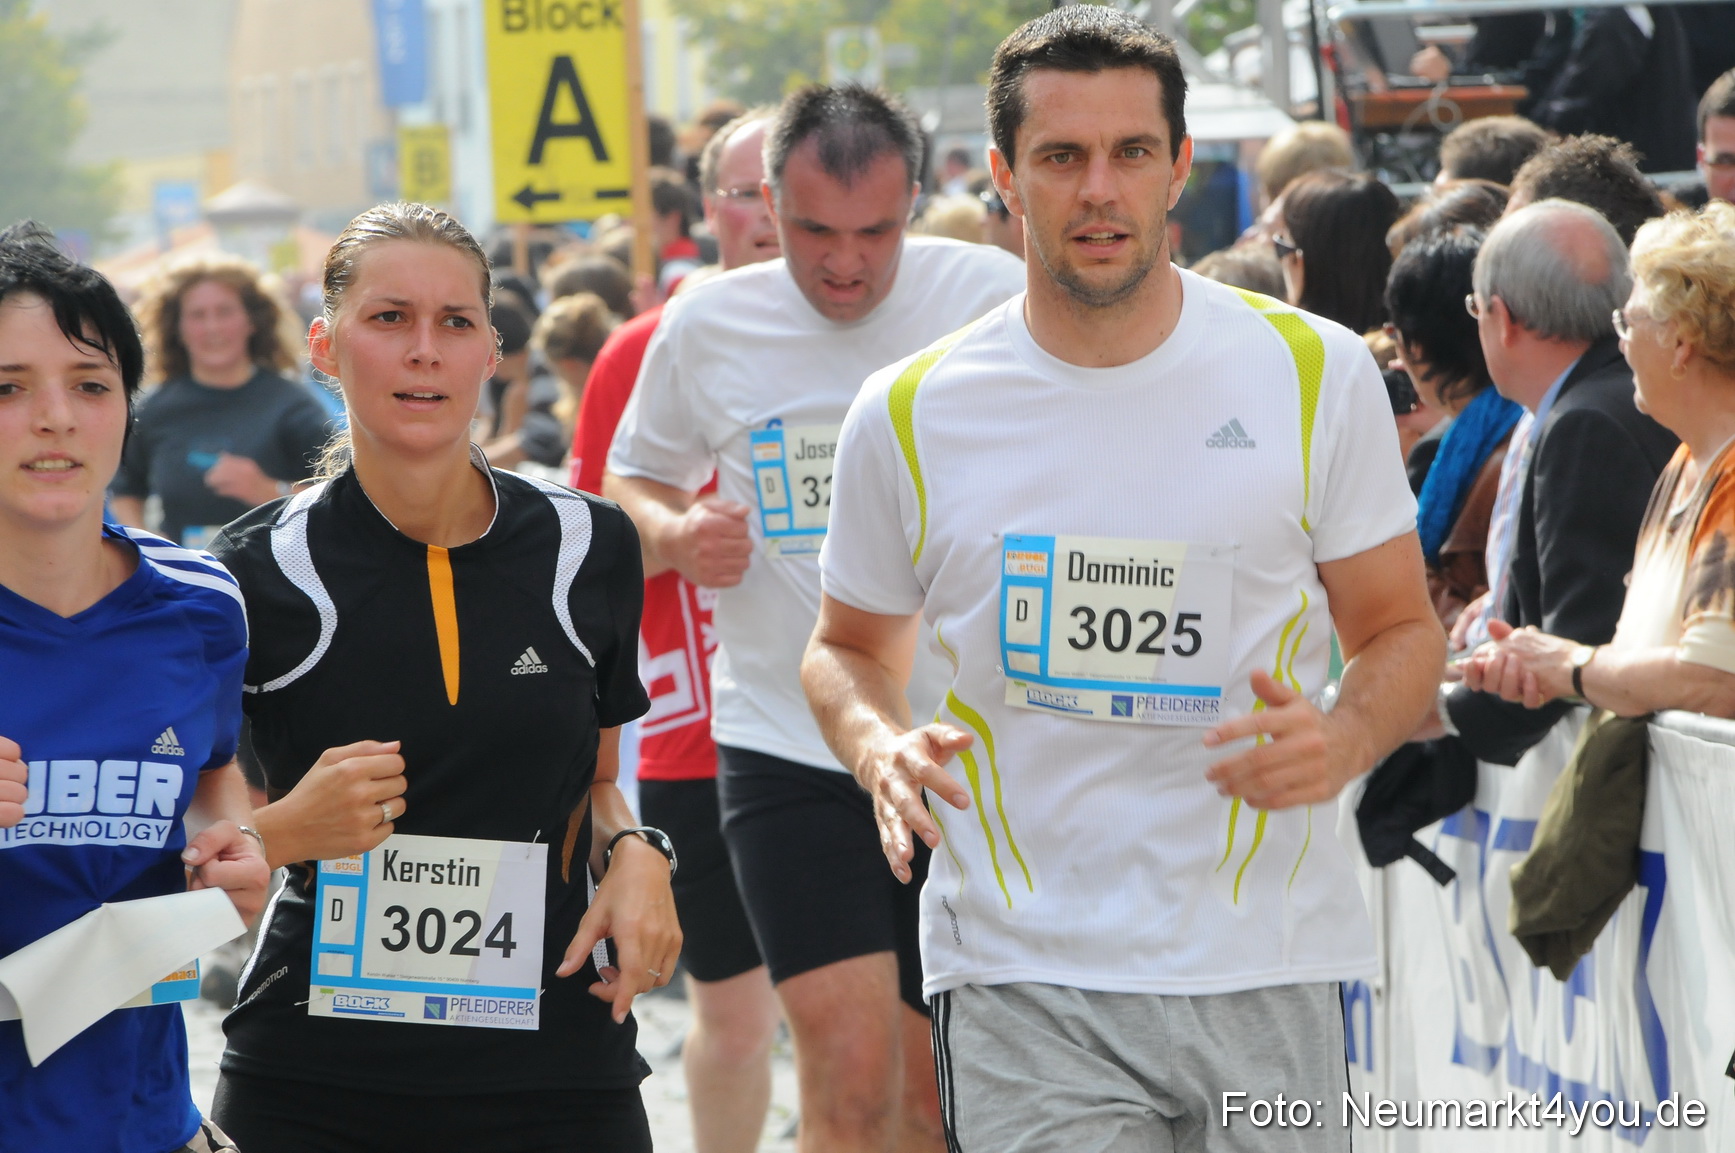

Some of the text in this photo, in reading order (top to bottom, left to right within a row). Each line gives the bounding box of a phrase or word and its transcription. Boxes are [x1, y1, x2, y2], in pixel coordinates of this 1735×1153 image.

[502, 0, 624, 33] Block
[527, 55, 610, 164] A
[1205, 436, 1256, 449] adidas
[1068, 551, 1175, 588] Dominic
[1016, 599, 1028, 622] D
[1067, 605, 1203, 657] 3025
[510, 664, 549, 676] adidas
[1136, 695, 1220, 713] PFLEIDERER
[151, 742, 185, 757] adidas
[1, 820, 168, 843] TECHNOLOGY
[382, 849, 481, 888] Kerstin
[331, 898, 344, 922] D
[380, 904, 518, 959] 3024
[333, 994, 391, 1010] BOCK
[450, 997, 535, 1016] PFLEIDERER
[449, 1014, 535, 1026] AKTIENGESELLSCHAFT
